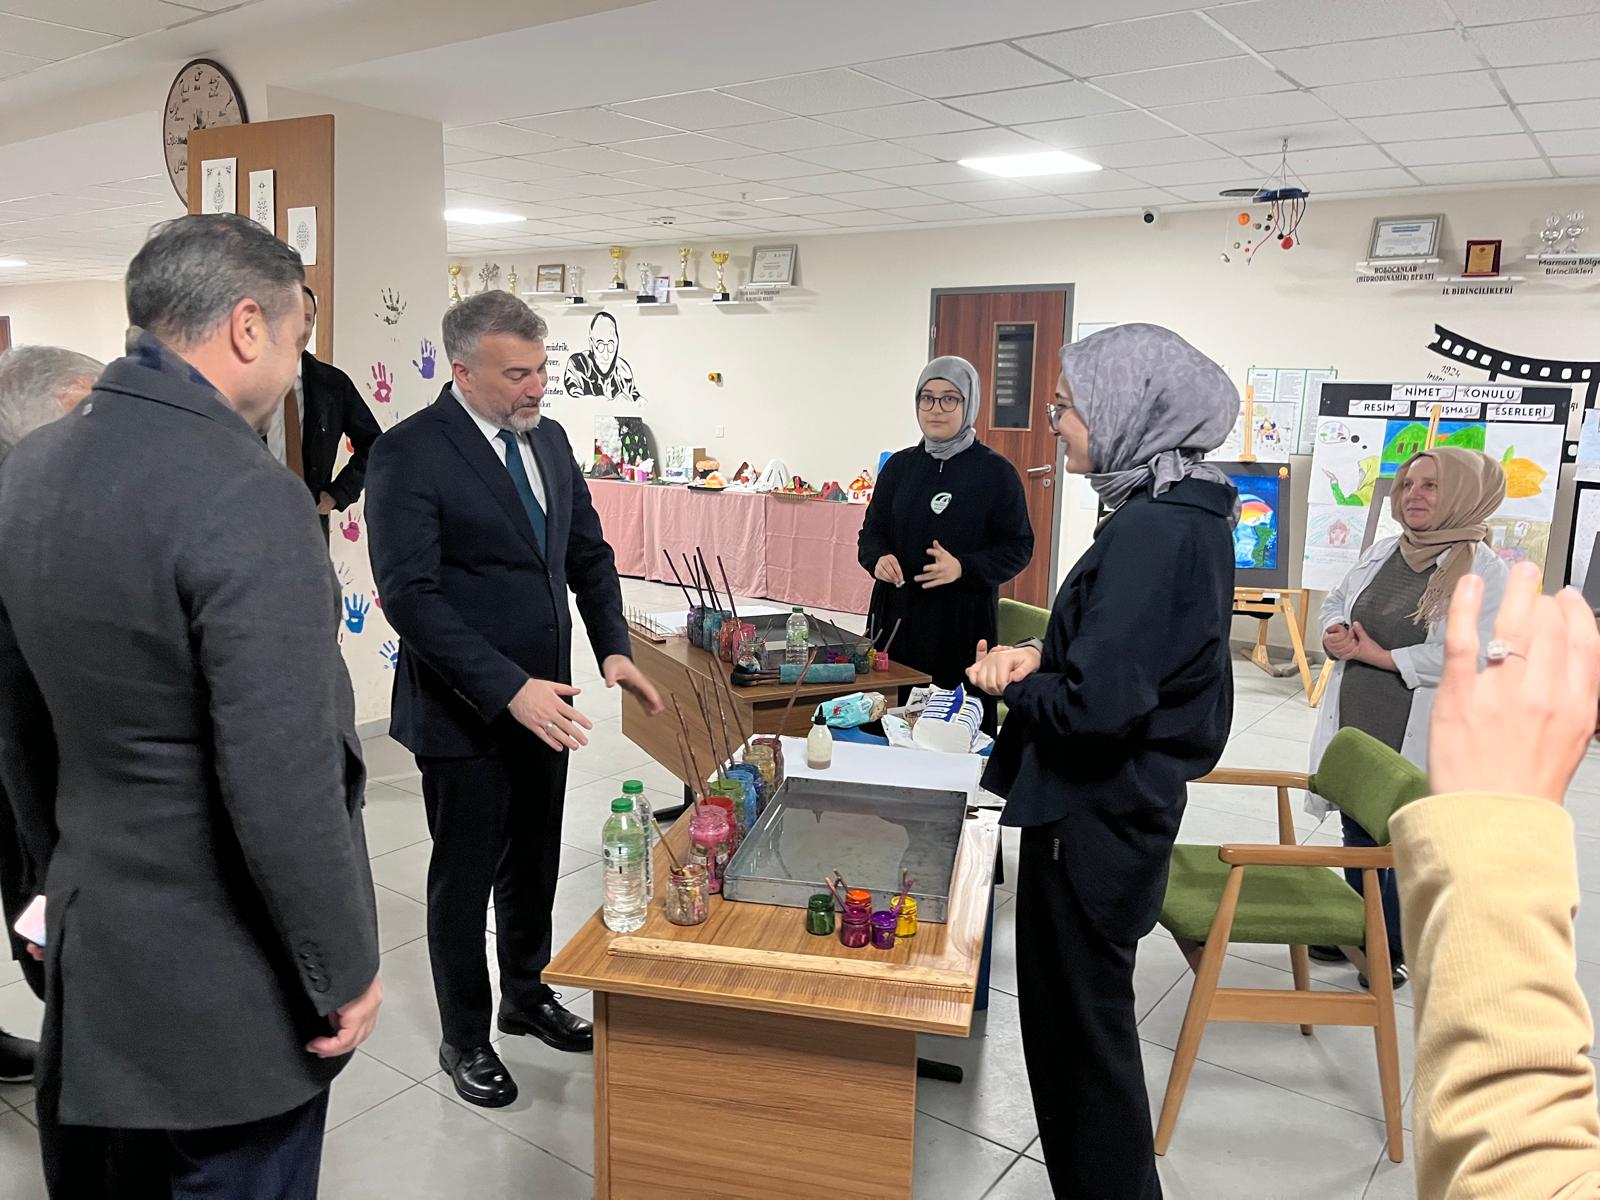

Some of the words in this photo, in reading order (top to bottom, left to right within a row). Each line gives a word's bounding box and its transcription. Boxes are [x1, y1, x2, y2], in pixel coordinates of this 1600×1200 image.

[1538, 259, 1577, 267] Marmara
[1545, 267, 1594, 276] Birincilikleri
[1405, 385, 1442, 397] NİMET
[1463, 387, 1516, 400] KONULU
[1364, 402, 1396, 412] RESİM
[1424, 405, 1473, 415] YIŞMASI
[1495, 406, 1547, 417] ESERLERİ
